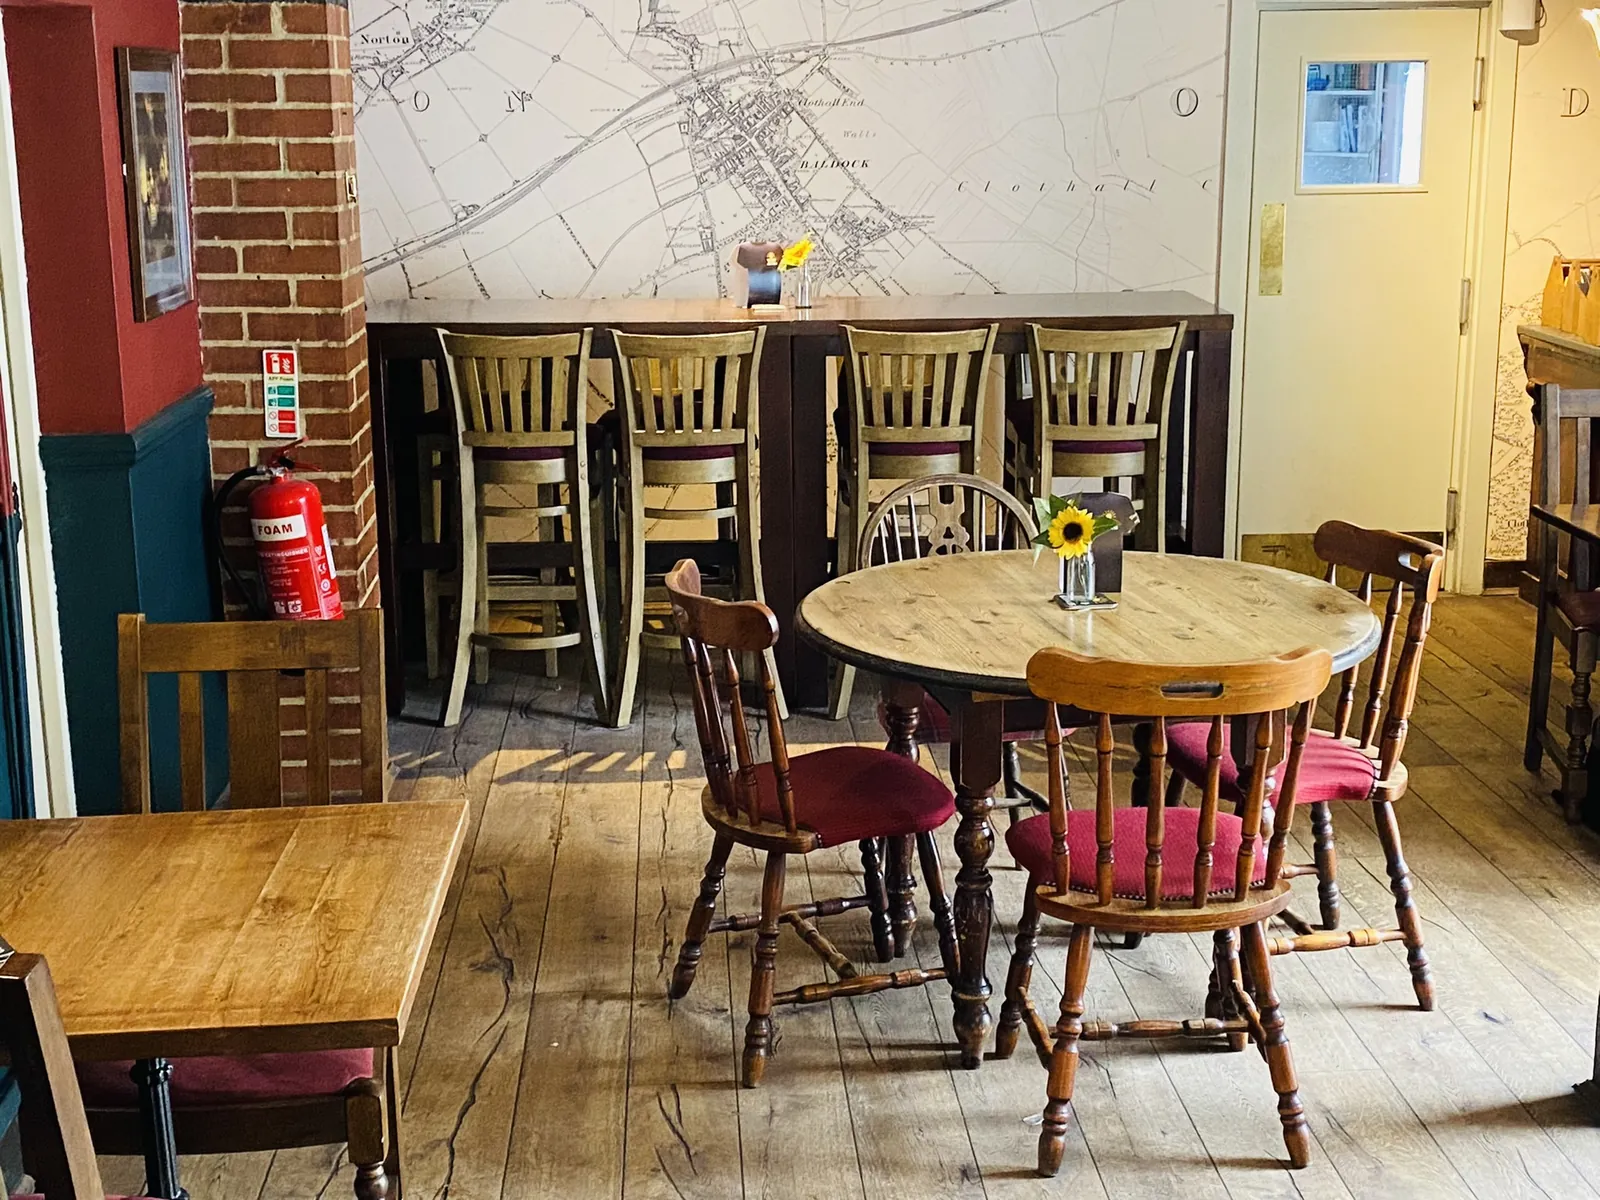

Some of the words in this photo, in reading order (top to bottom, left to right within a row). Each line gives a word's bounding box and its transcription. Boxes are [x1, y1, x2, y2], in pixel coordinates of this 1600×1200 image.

[360, 34, 410, 45] Norton
[841, 98, 865, 107] End
[1560, 87, 1590, 118] D
[800, 160, 869, 169] BALDOCK
[257, 523, 293, 536] FOAM
